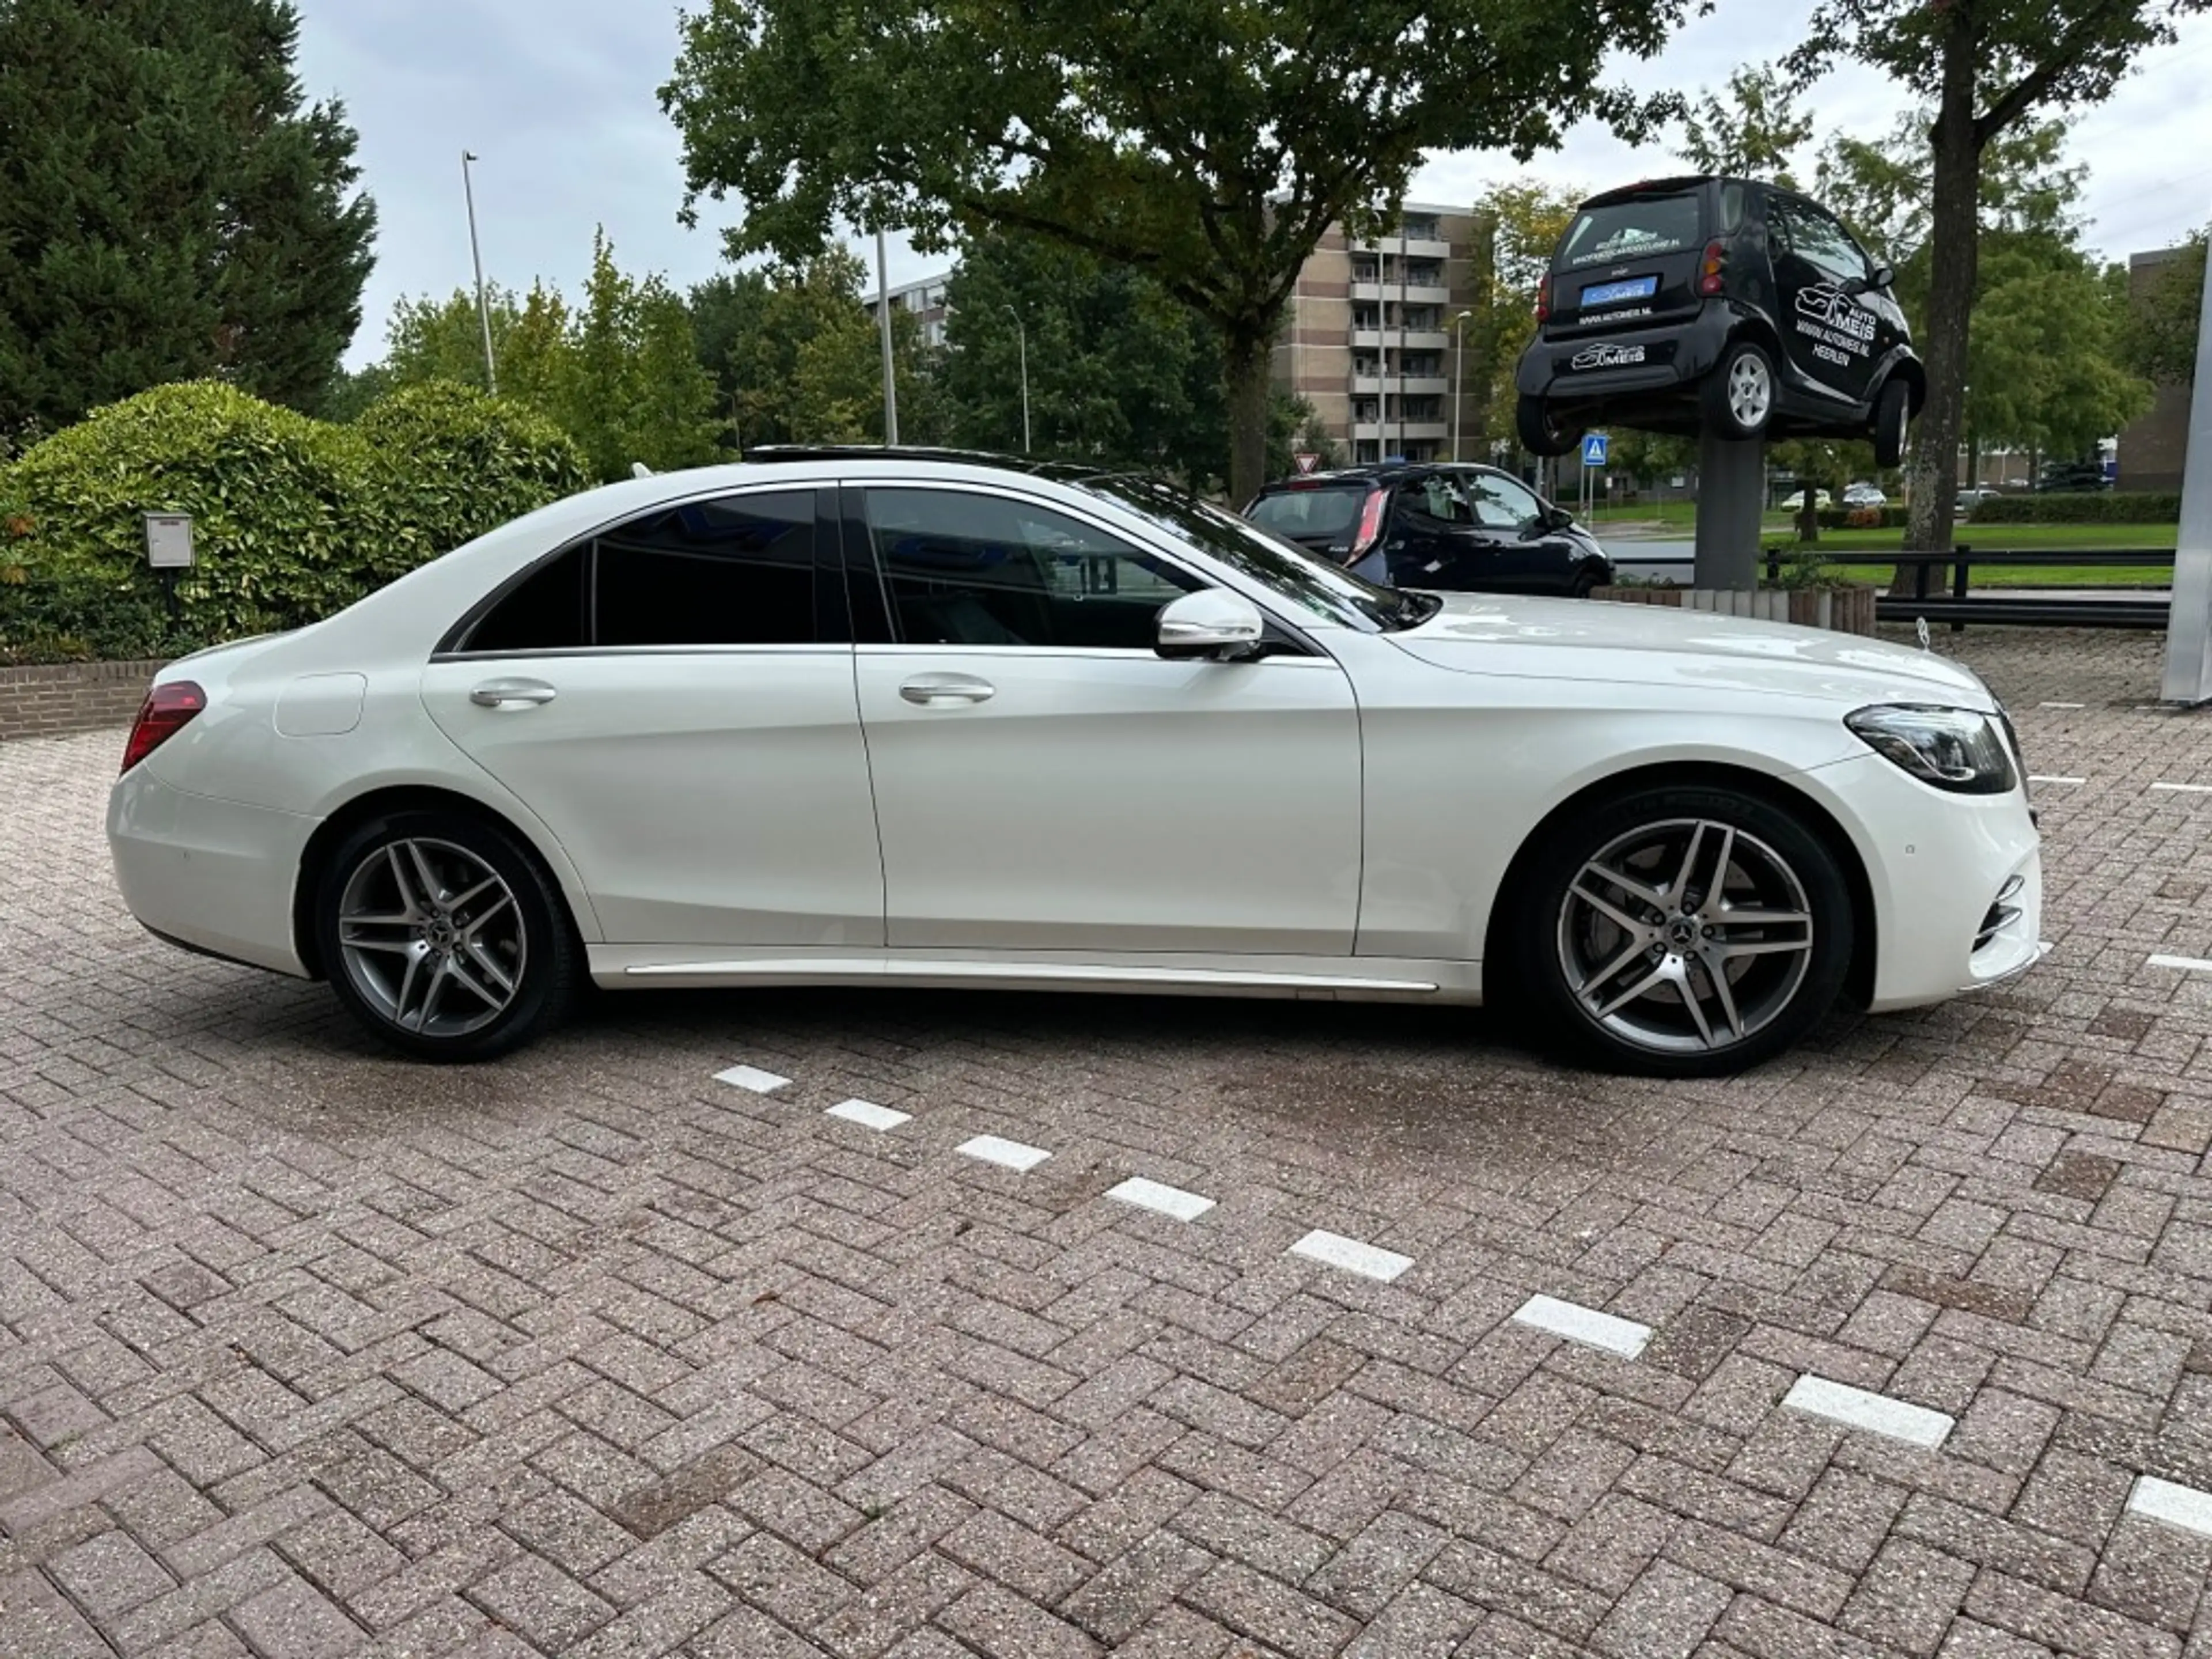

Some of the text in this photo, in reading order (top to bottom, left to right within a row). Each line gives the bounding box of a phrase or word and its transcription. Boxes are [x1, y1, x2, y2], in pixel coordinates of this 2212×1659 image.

[1836, 313, 1876, 340] MEIS
[1849, 307, 1876, 325] AUTO
[1606, 351, 1645, 365] MEIS
[1812, 343, 1850, 367] HEERLEN
